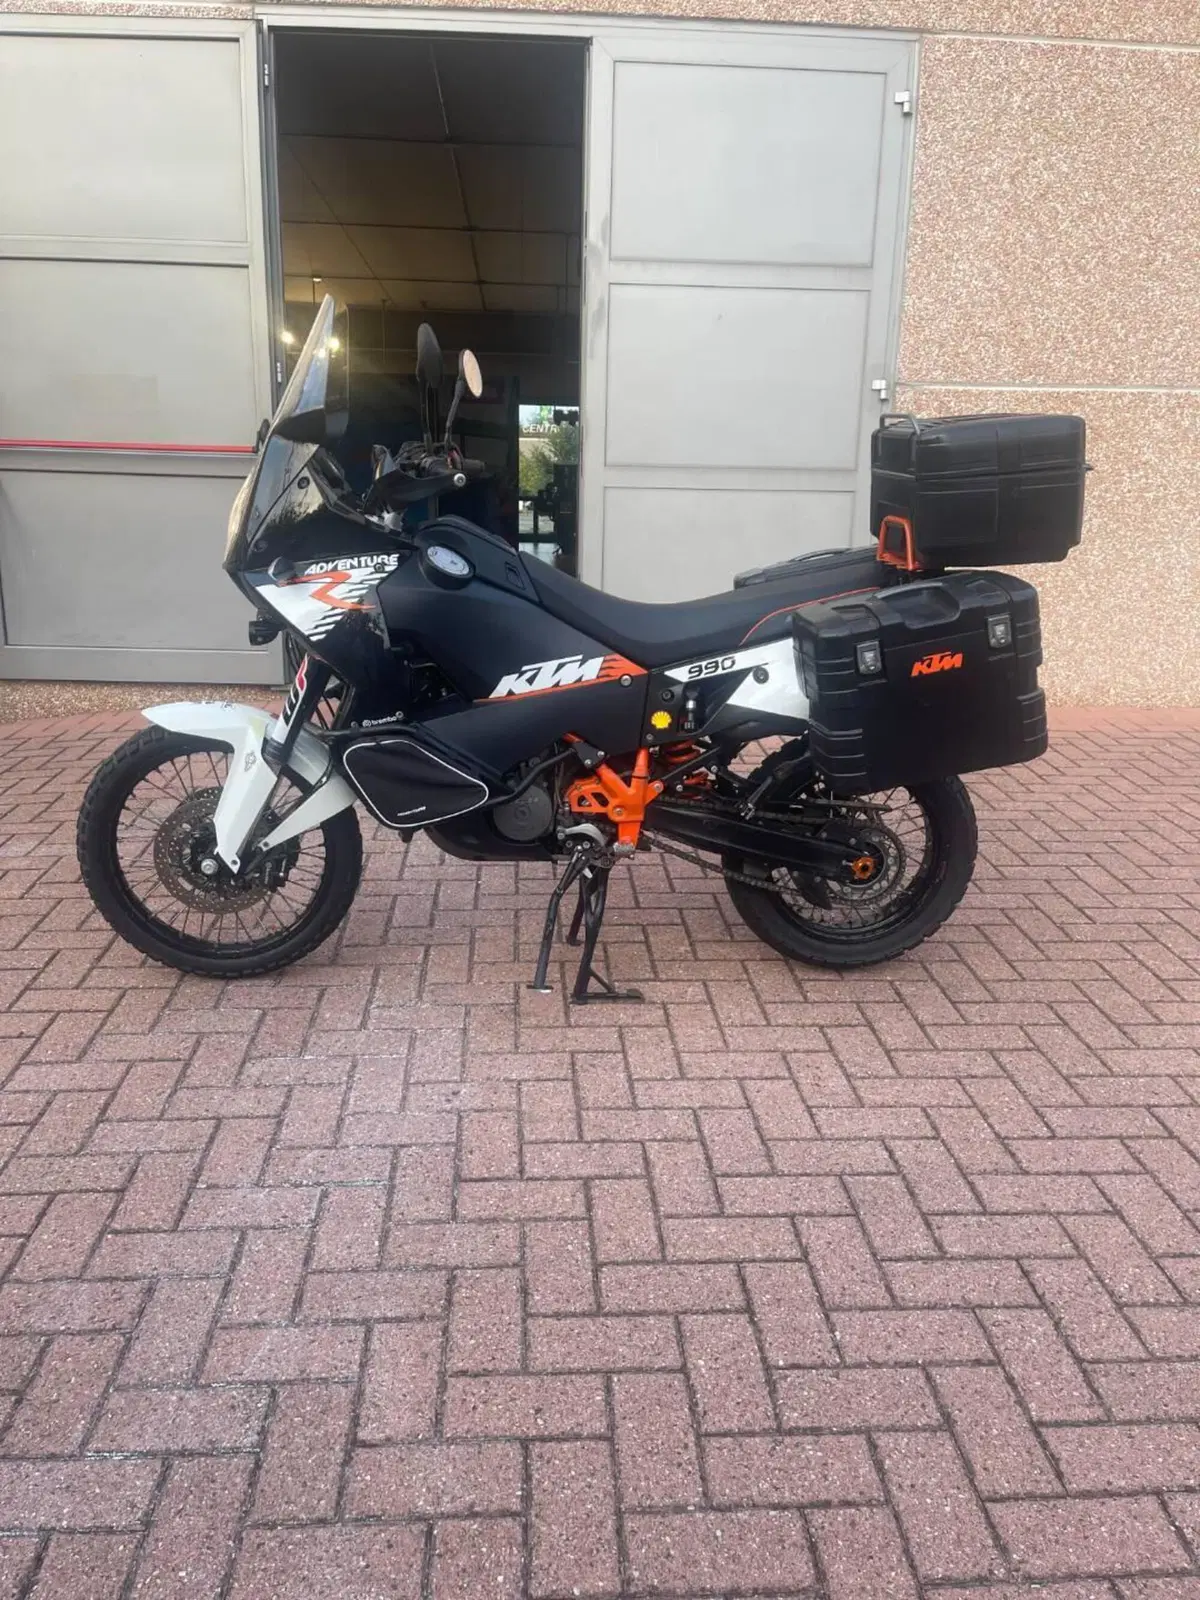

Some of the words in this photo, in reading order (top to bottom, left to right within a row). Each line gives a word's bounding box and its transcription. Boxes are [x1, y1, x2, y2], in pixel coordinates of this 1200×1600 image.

[304, 554, 400, 575] ADVENTURE
[489, 654, 605, 699] KTM
[688, 656, 736, 679] 990
[911, 652, 963, 678] KTM
[370, 715, 398, 726] brembo
